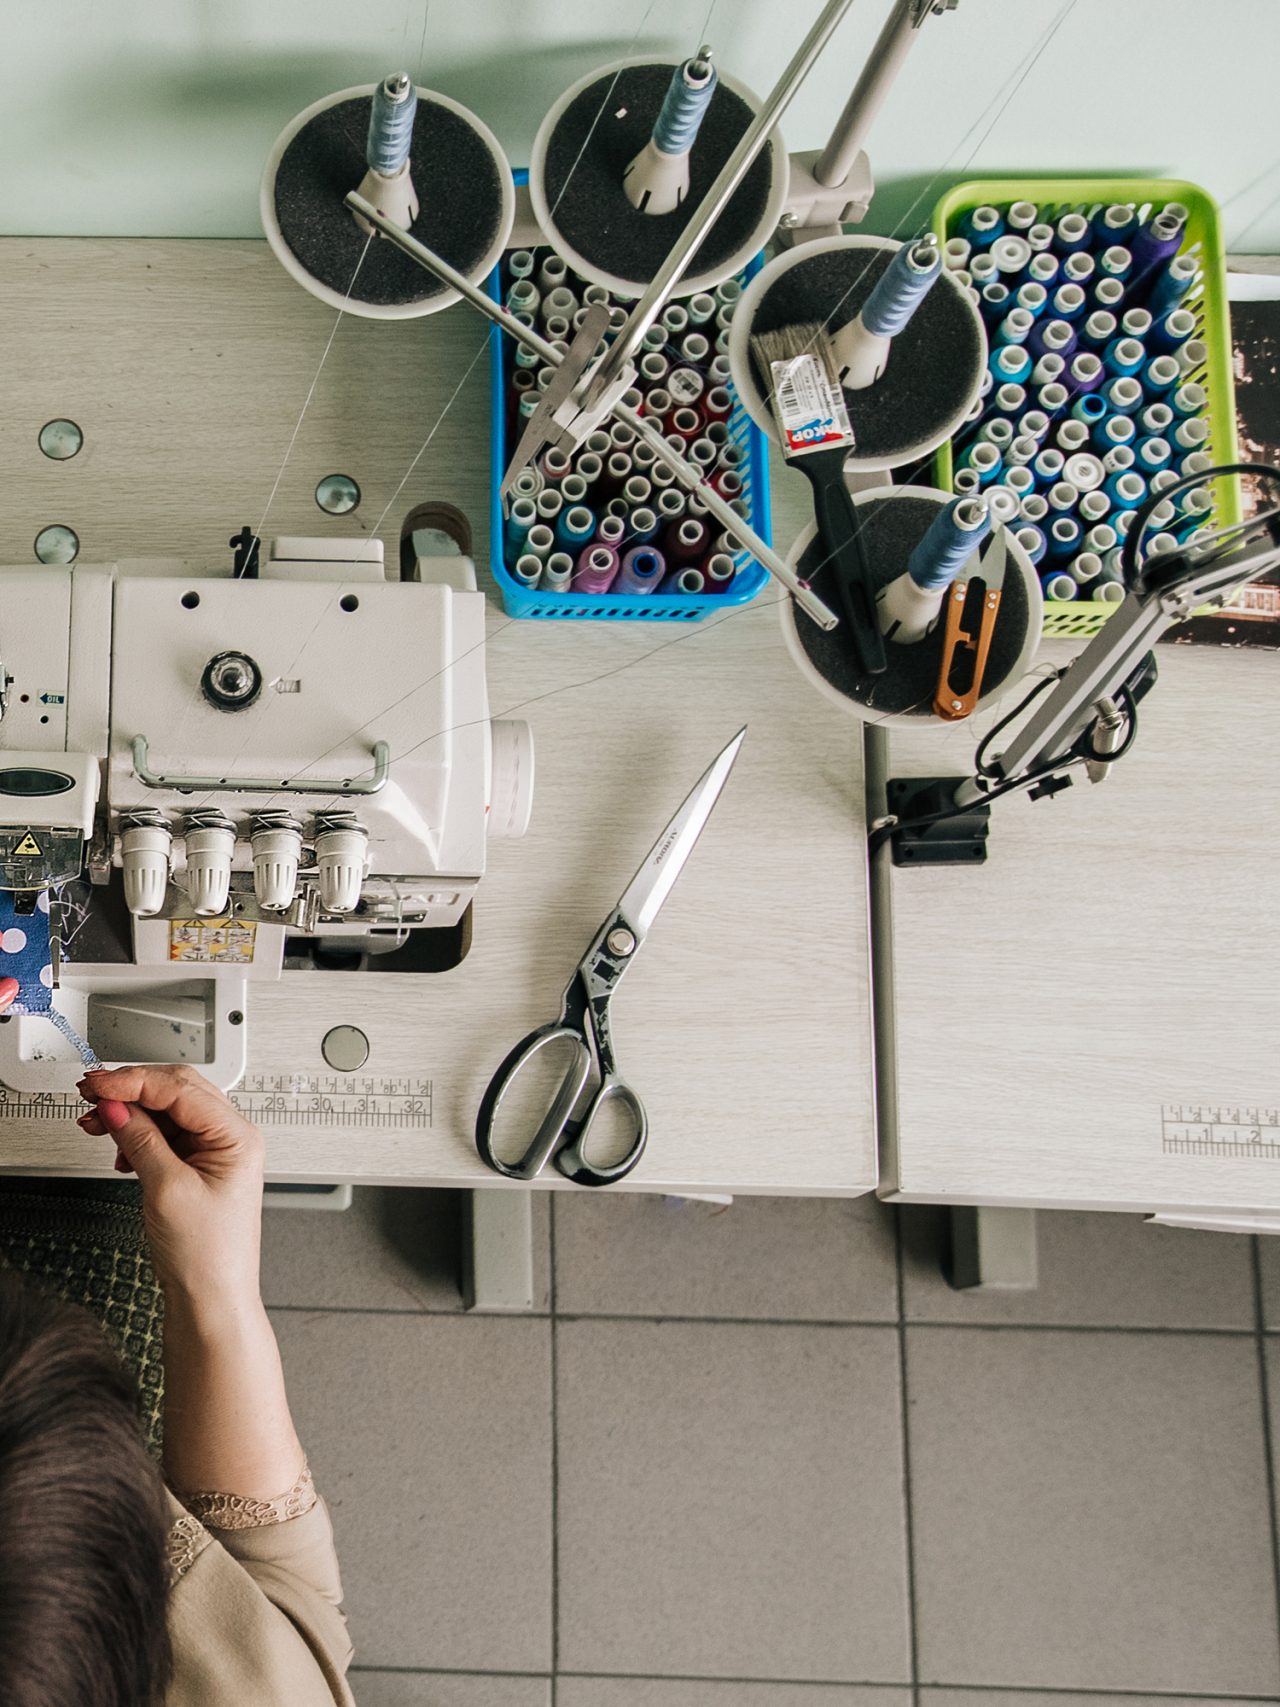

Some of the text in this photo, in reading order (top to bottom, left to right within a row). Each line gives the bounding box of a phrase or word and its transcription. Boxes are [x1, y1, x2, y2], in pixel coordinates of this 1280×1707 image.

[47, 695, 60, 703] OIL
[256, 1081, 262, 1090] 3
[310, 1082, 317, 1092] 6
[329, 1083, 335, 1092] 7
[346, 1083, 353, 1093] 8
[365, 1084, 371, 1093] 9
[420, 1085, 427, 1094] 2
[33, 1092, 53, 1104] 24
[264, 1097, 285, 1110] 29
[311, 1098, 331, 1110] 30
[357, 1099, 376, 1112] 31
[404, 1100, 423, 1113] 32
[1250, 1130, 1260, 1143] 2
